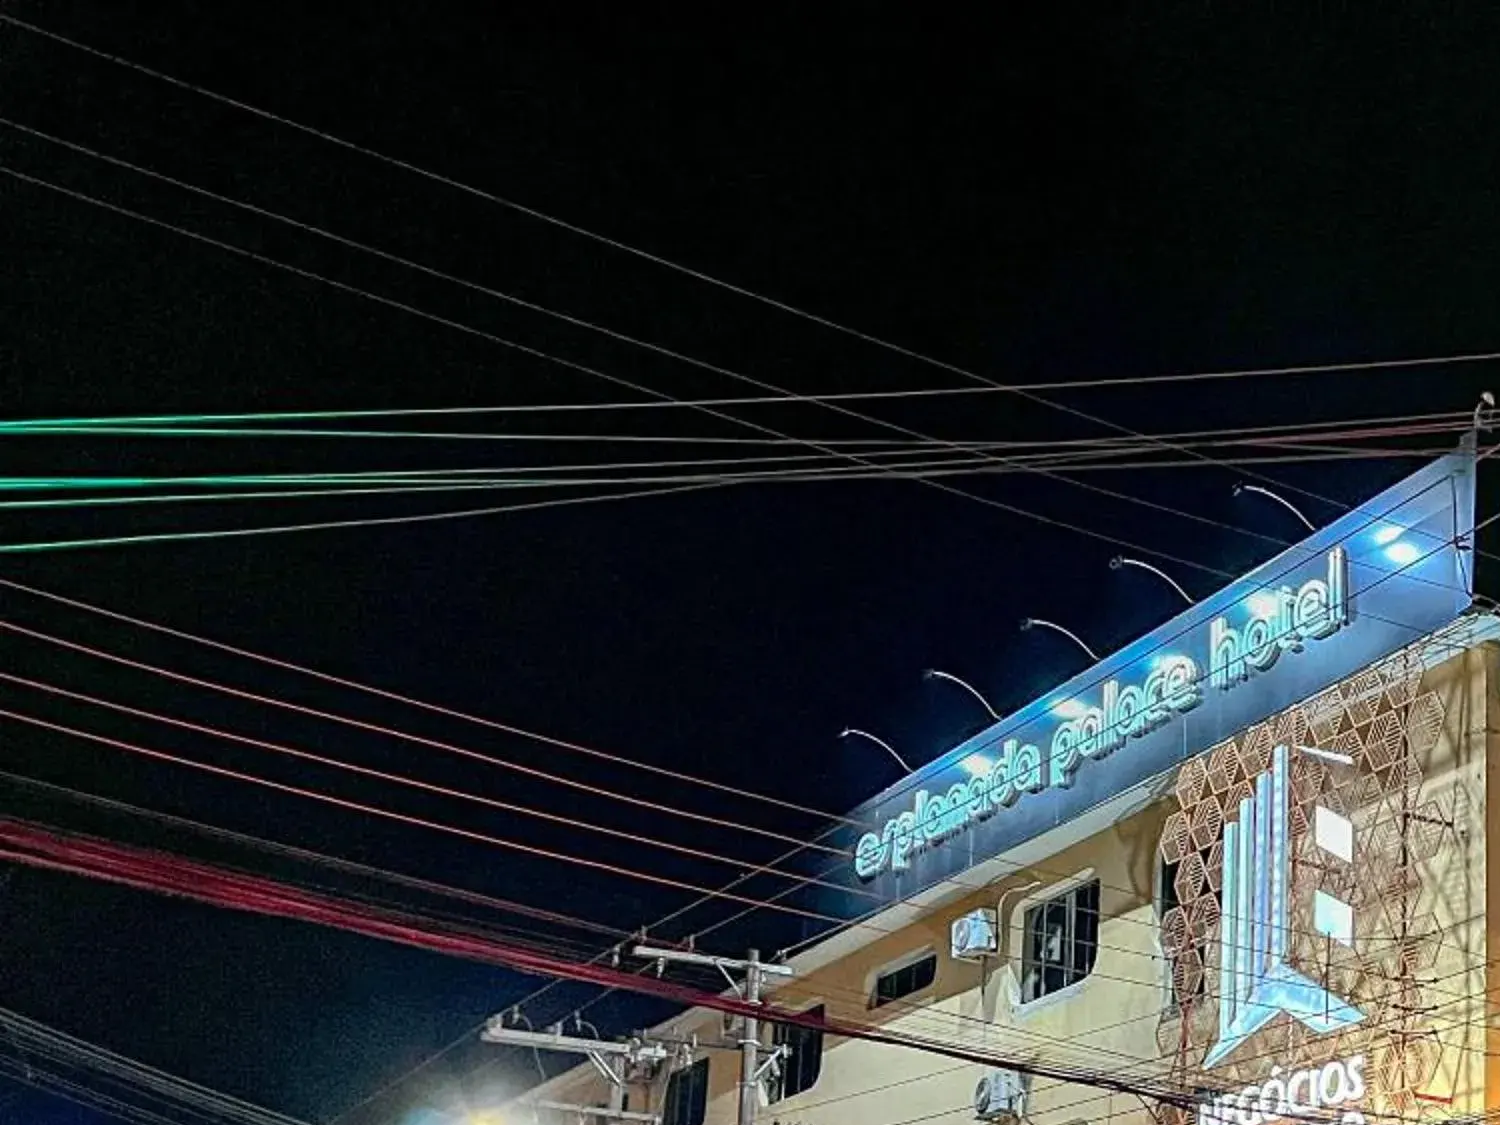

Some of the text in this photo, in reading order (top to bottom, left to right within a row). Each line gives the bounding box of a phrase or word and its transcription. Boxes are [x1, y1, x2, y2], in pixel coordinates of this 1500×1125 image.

[855, 546, 1348, 880] esplanada palace hotel
